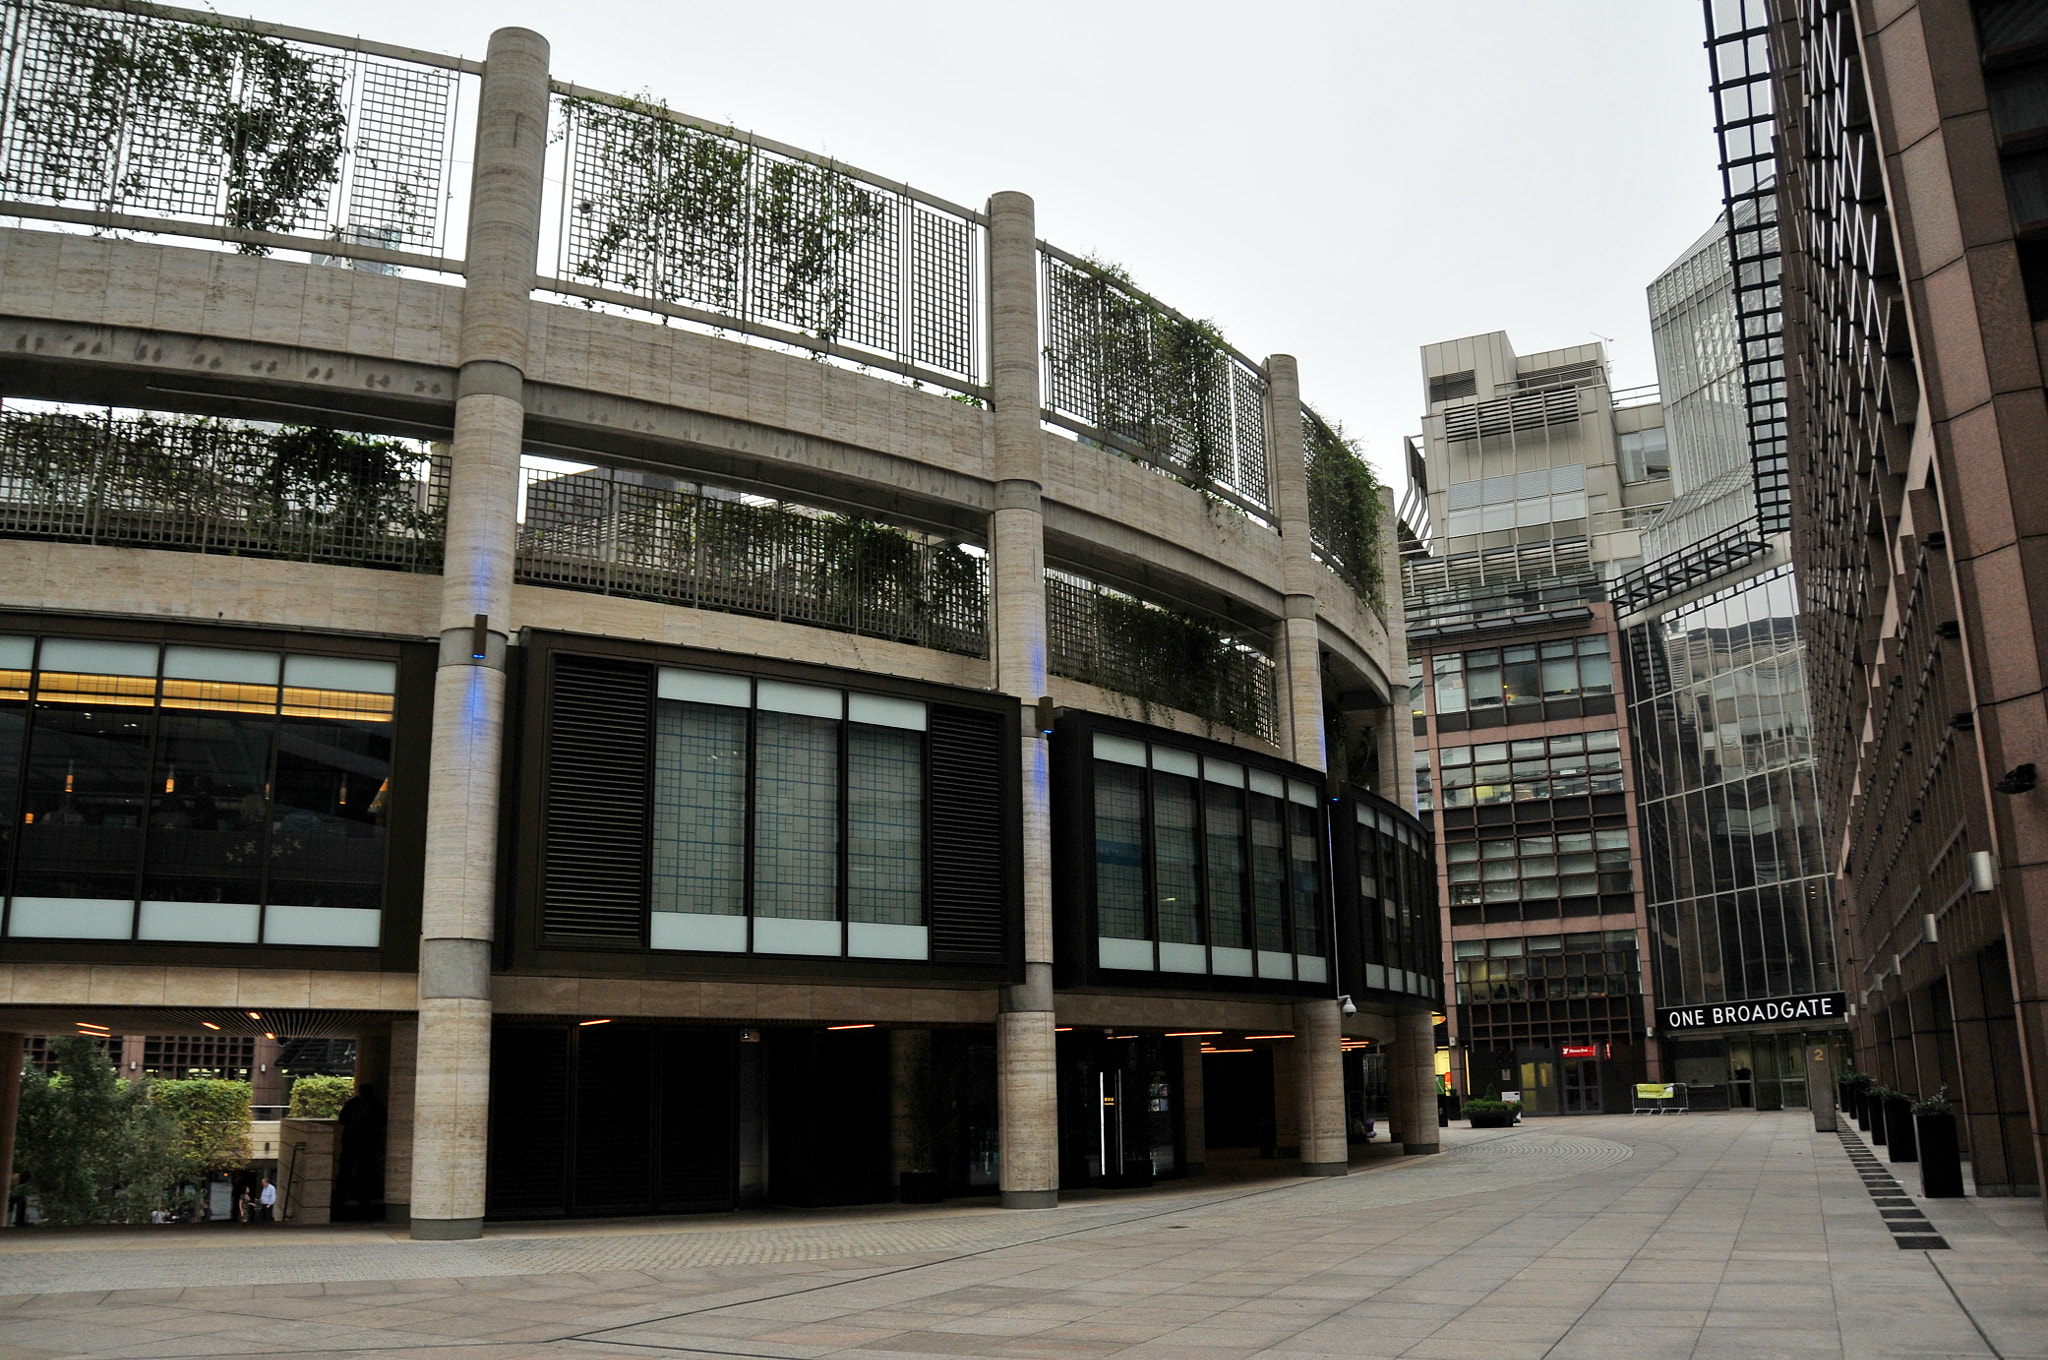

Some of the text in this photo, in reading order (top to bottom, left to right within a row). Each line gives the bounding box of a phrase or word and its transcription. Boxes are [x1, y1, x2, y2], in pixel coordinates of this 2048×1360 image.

[1669, 998, 1833, 1028] ONE BROADGATE
[1814, 1049, 1824, 1061] 2
